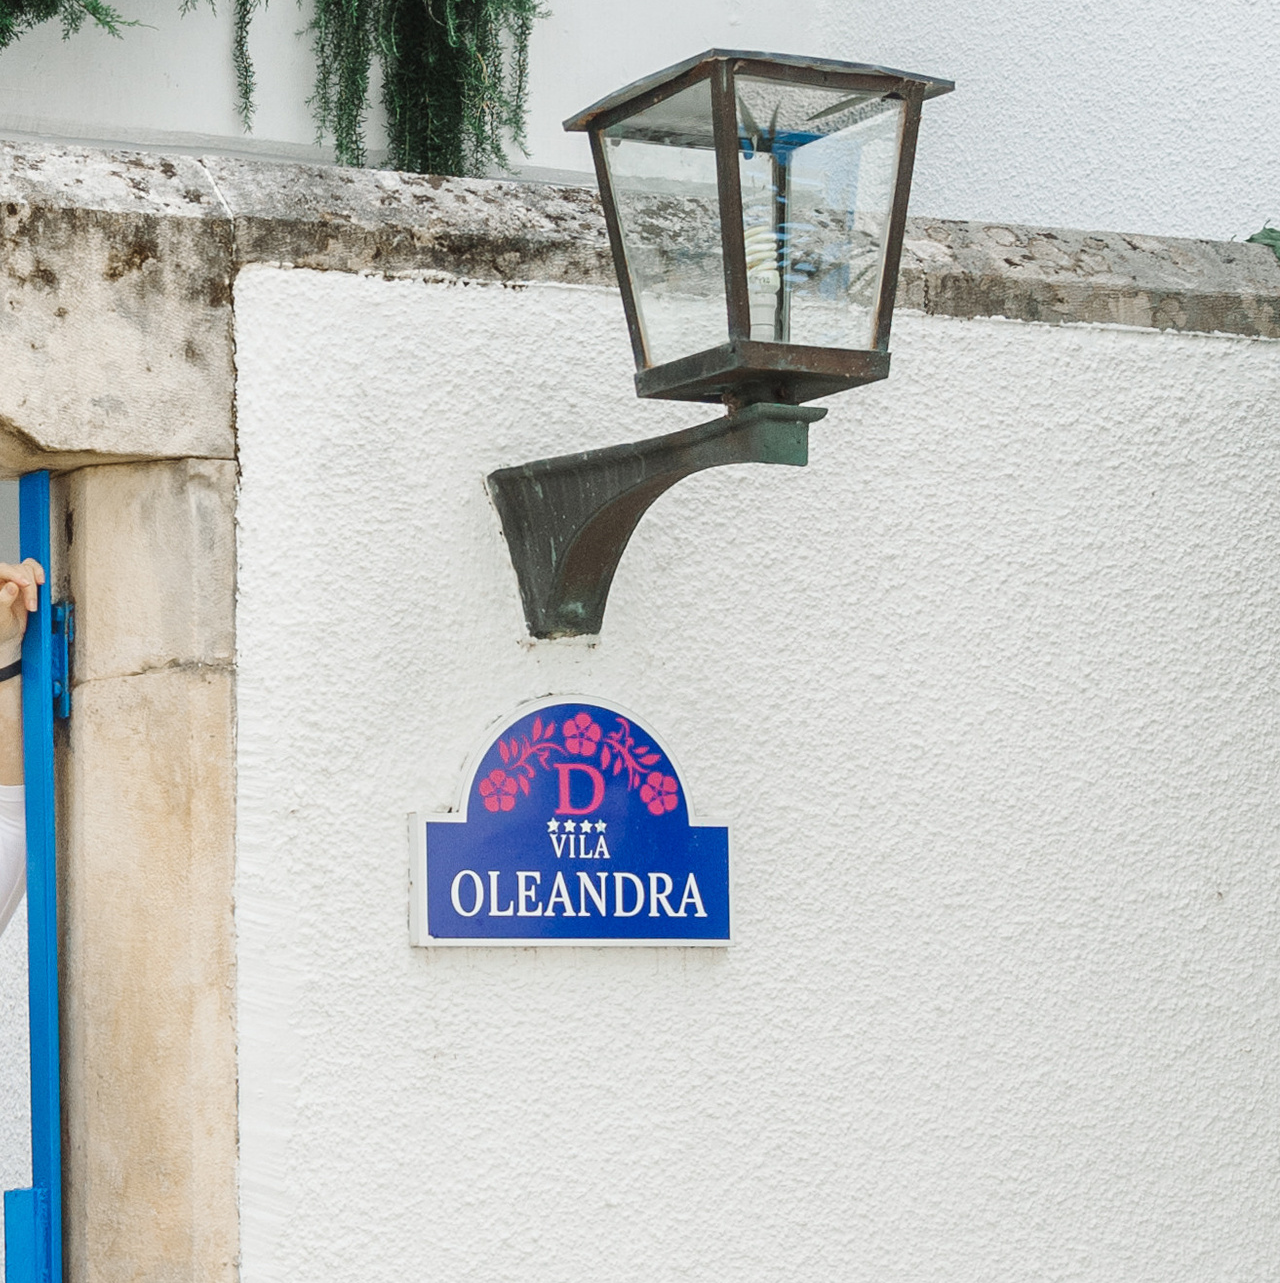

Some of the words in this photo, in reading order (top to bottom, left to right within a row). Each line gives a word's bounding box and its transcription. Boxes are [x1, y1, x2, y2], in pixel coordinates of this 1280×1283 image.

[553, 763, 605, 815] D
[549, 834, 610, 859] VILA
[450, 869, 708, 917] OLEANDRA
